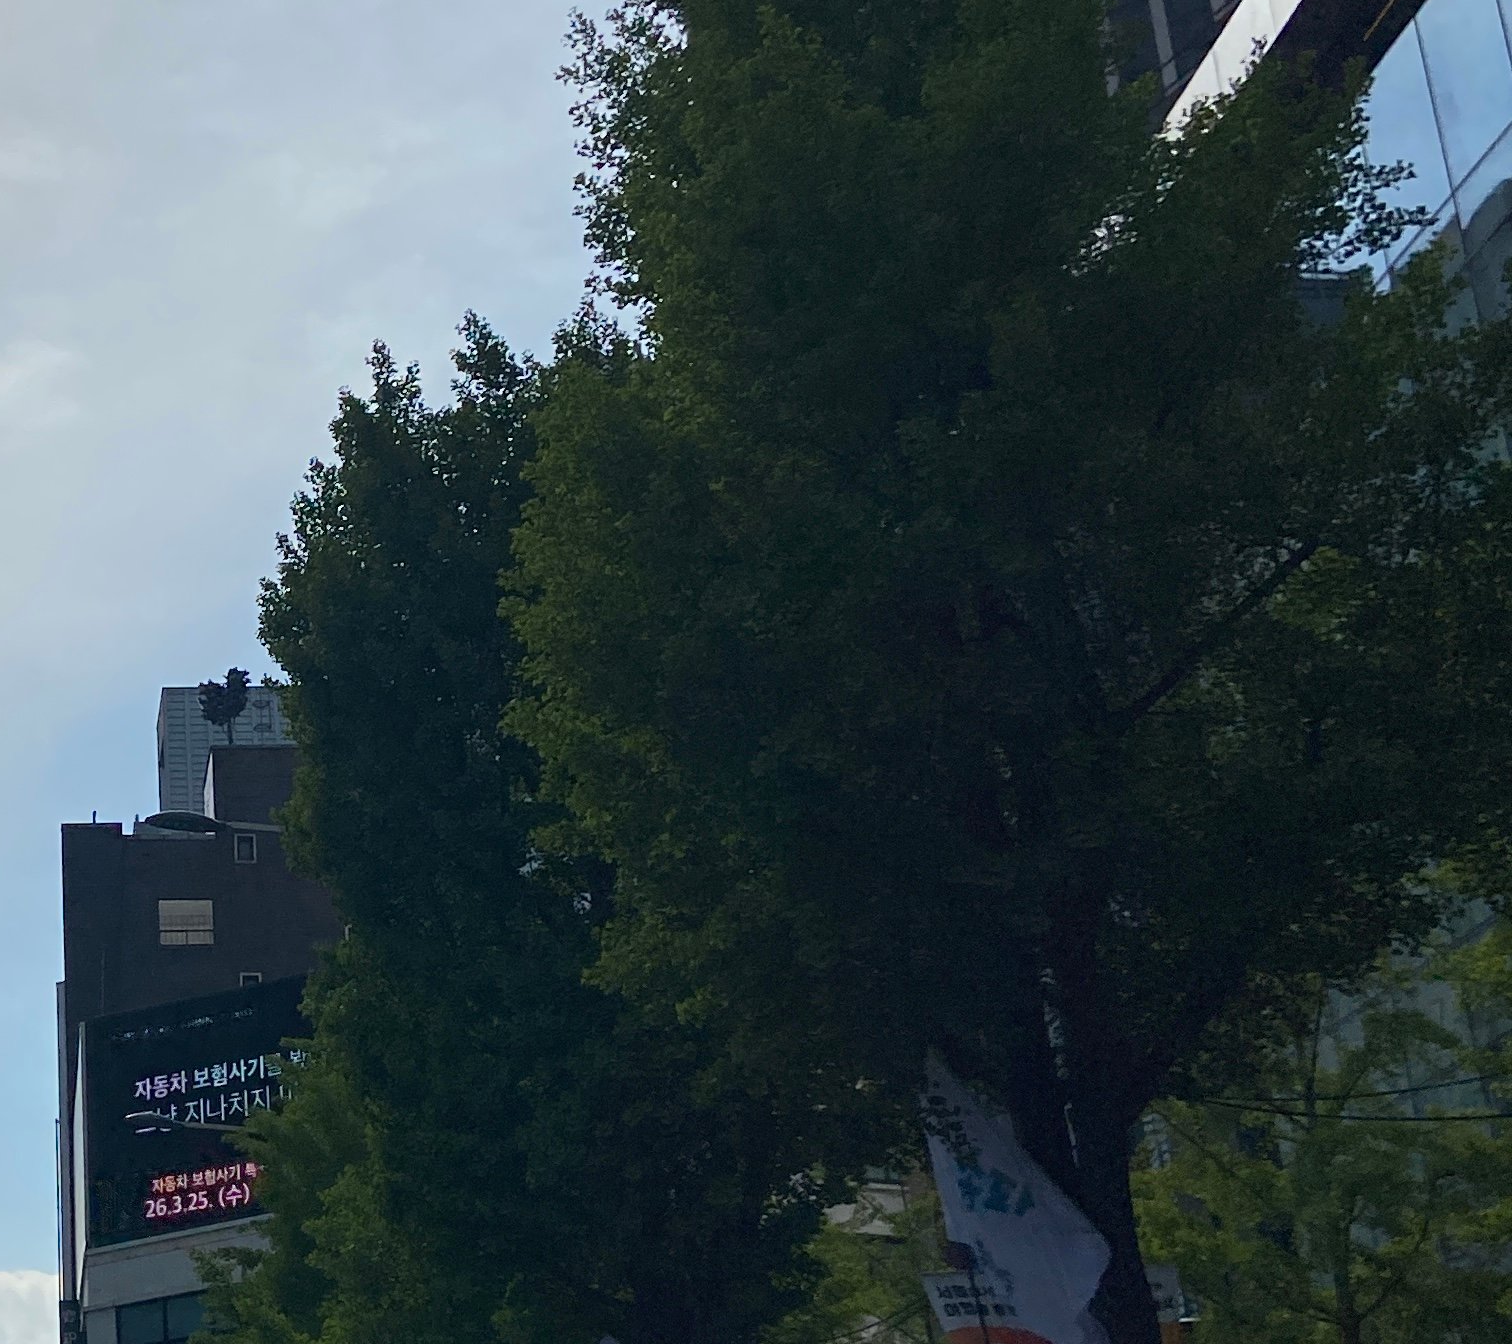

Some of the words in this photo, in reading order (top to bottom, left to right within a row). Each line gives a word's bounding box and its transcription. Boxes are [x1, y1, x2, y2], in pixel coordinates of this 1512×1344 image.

[134, 1069, 188, 1101] 자동차
[185, 1085, 271, 1124] 지나치지
[152, 1172, 188, 1194] 자동차
[192, 1164, 241, 1187] 보험사기
[145, 1190, 214, 1218] 26.3.25.
[218, 1182, 250, 1208] (수)
